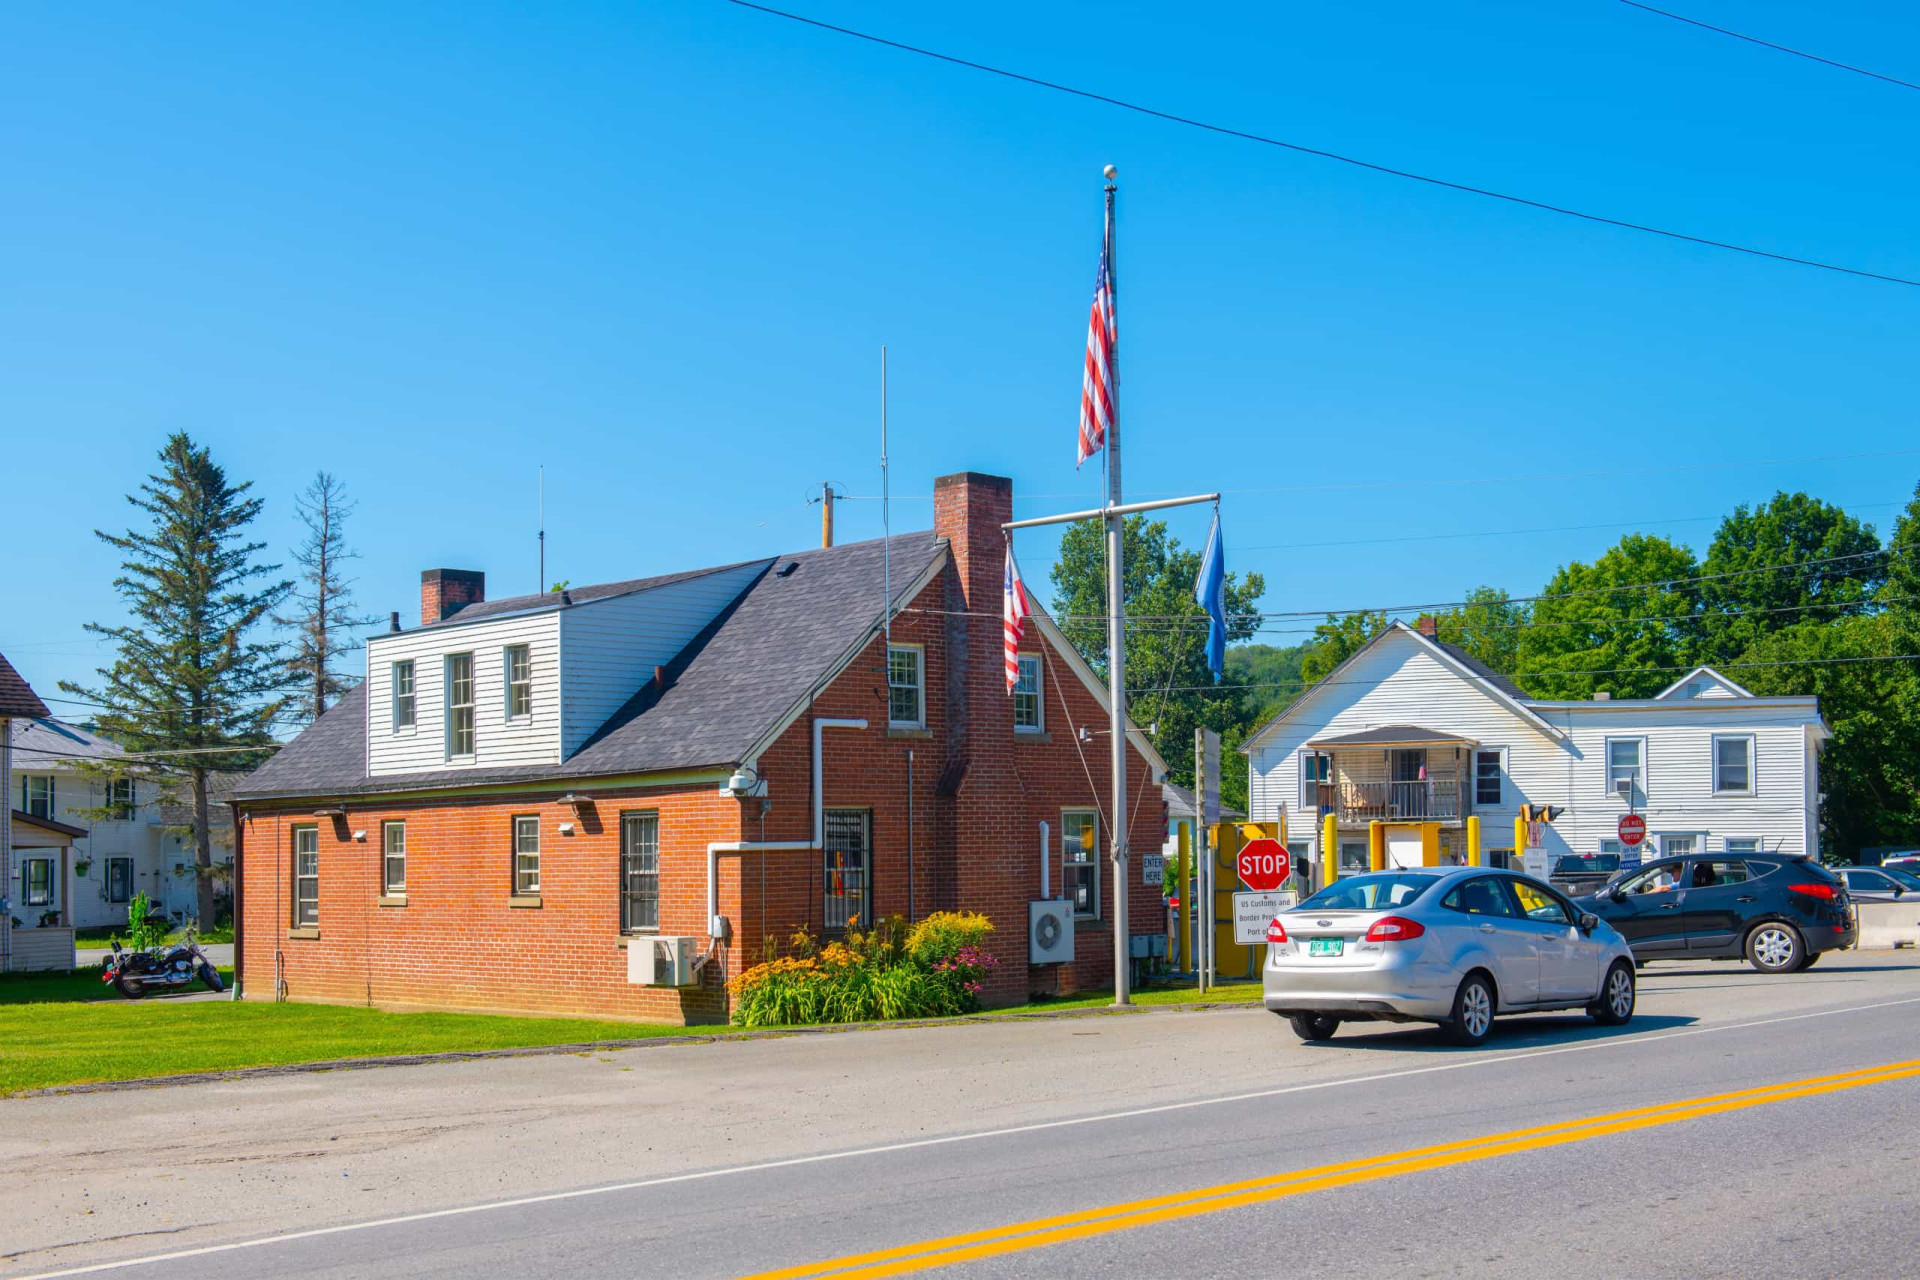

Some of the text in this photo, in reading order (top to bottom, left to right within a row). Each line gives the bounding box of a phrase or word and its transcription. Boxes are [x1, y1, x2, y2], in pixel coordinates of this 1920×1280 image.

[1144, 858, 1163, 868] ENTER
[1241, 854, 1287, 875] STOP
[1145, 871, 1162, 881] HERE
[1250, 900, 1277, 908] Customs
[1239, 913, 1277, 922] Border Prot
[1247, 928, 1261, 936] Port
